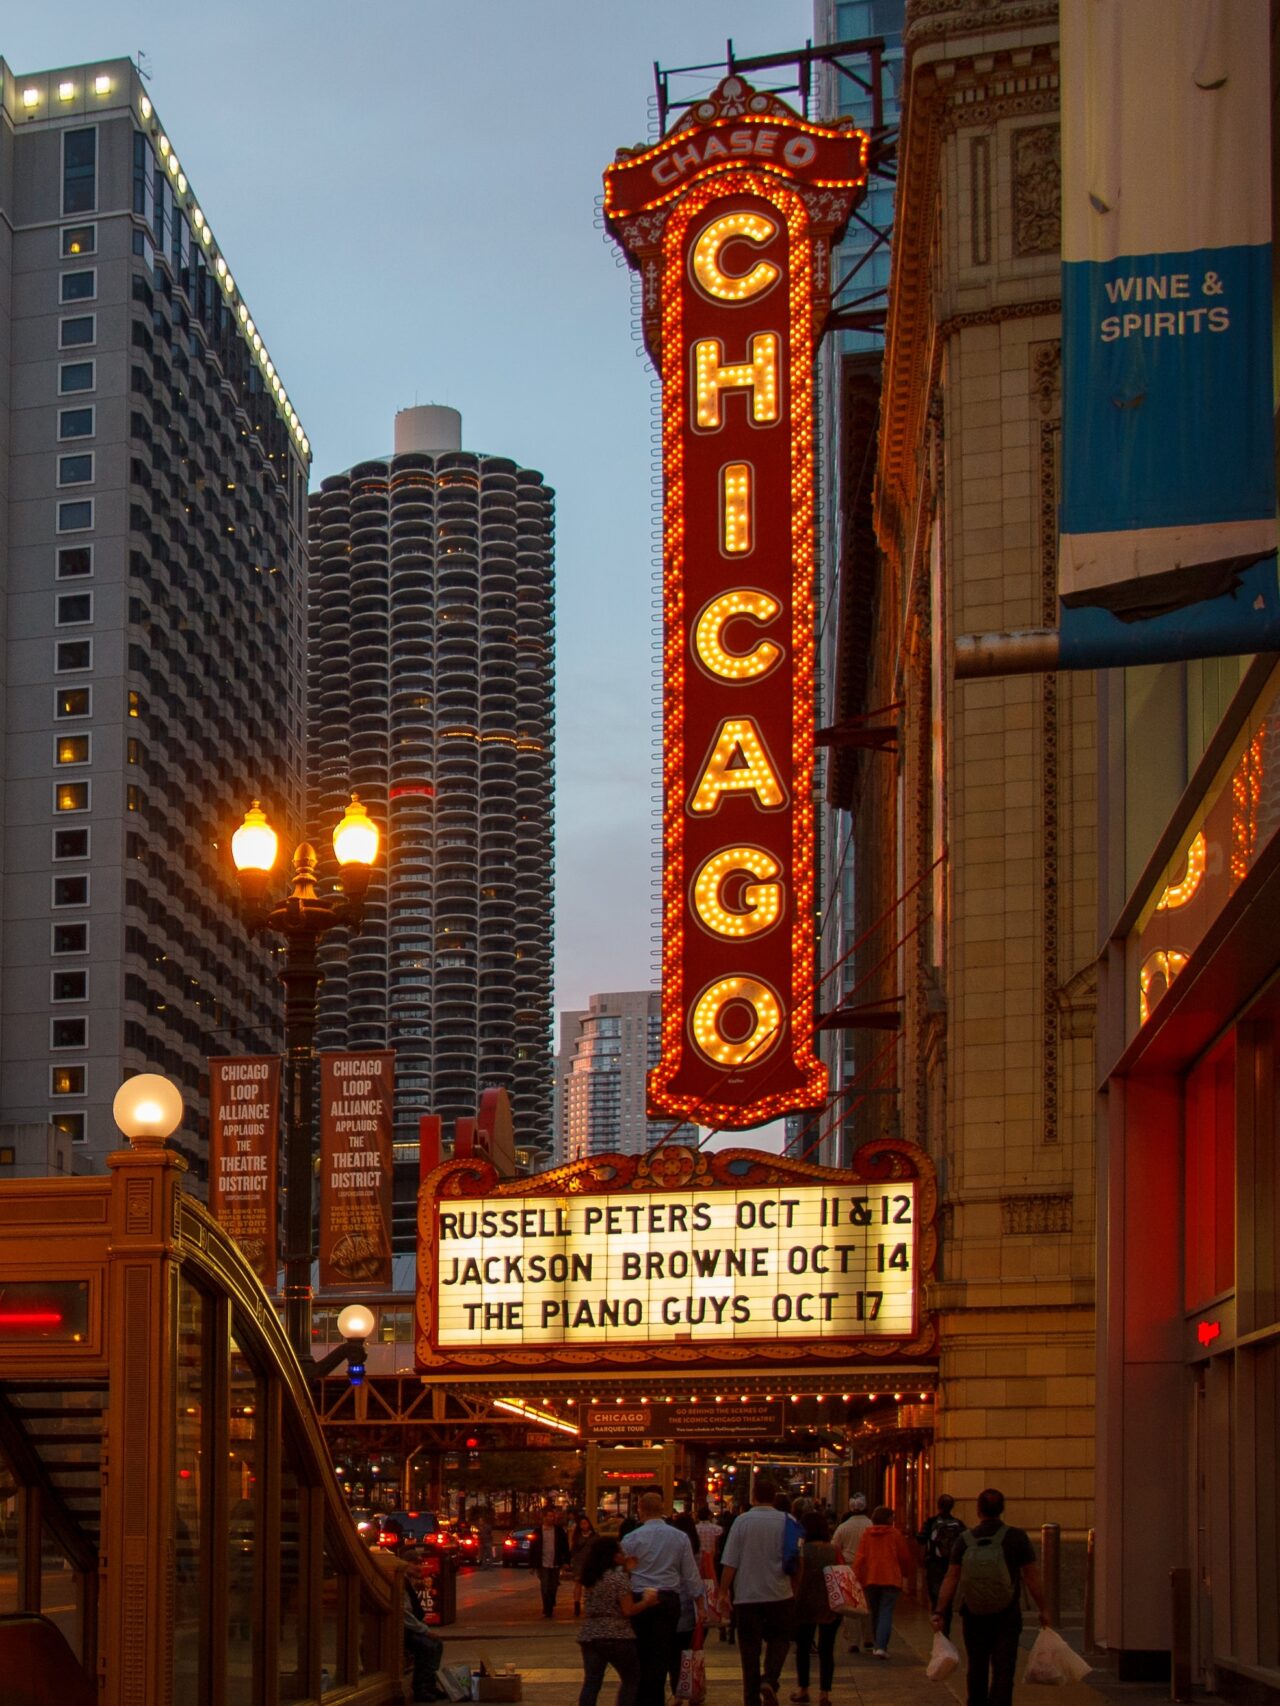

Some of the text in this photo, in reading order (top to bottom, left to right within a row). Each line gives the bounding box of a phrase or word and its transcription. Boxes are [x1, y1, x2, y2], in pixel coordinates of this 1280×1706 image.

[652, 130, 779, 185] CHASE
[1105, 271, 1223, 304] WINE &
[1100, 307, 1230, 342] SPIRITS
[691, 212, 784, 1067] CHICAGO
[221, 1064, 269, 1081] CHICAGO
[333, 1060, 382, 1077] CHICAGO
[230, 1084, 259, 1101] LOOP
[342, 1080, 372, 1096] LOOP
[219, 1104, 270, 1121] ALLIANCE
[330, 1100, 383, 1117] ALLIANCE
[223, 1124, 264, 1137] APPLAUDS
[335, 1120, 378, 1132] APPLAUDS
[236, 1140, 251, 1152] THE
[349, 1136, 364, 1148] THE
[220, 1156, 267, 1172] THEATRE
[332, 1151, 381, 1168] THEATRE
[219, 1176, 268, 1192] DISTRICT
[331, 1171, 382, 1189] DISTRICT
[439, 1207, 572, 1241] RUSSELL
[584, 1202, 713, 1236] PETERS
[735, 1199, 800, 1230] OCT
[441, 1242, 910, 1287] JACKSON BROWNE OCT 14
[463, 1291, 885, 1331] THE PIANO GUYS OCT 17
[594, 1414, 644, 1422] CHICAGO
